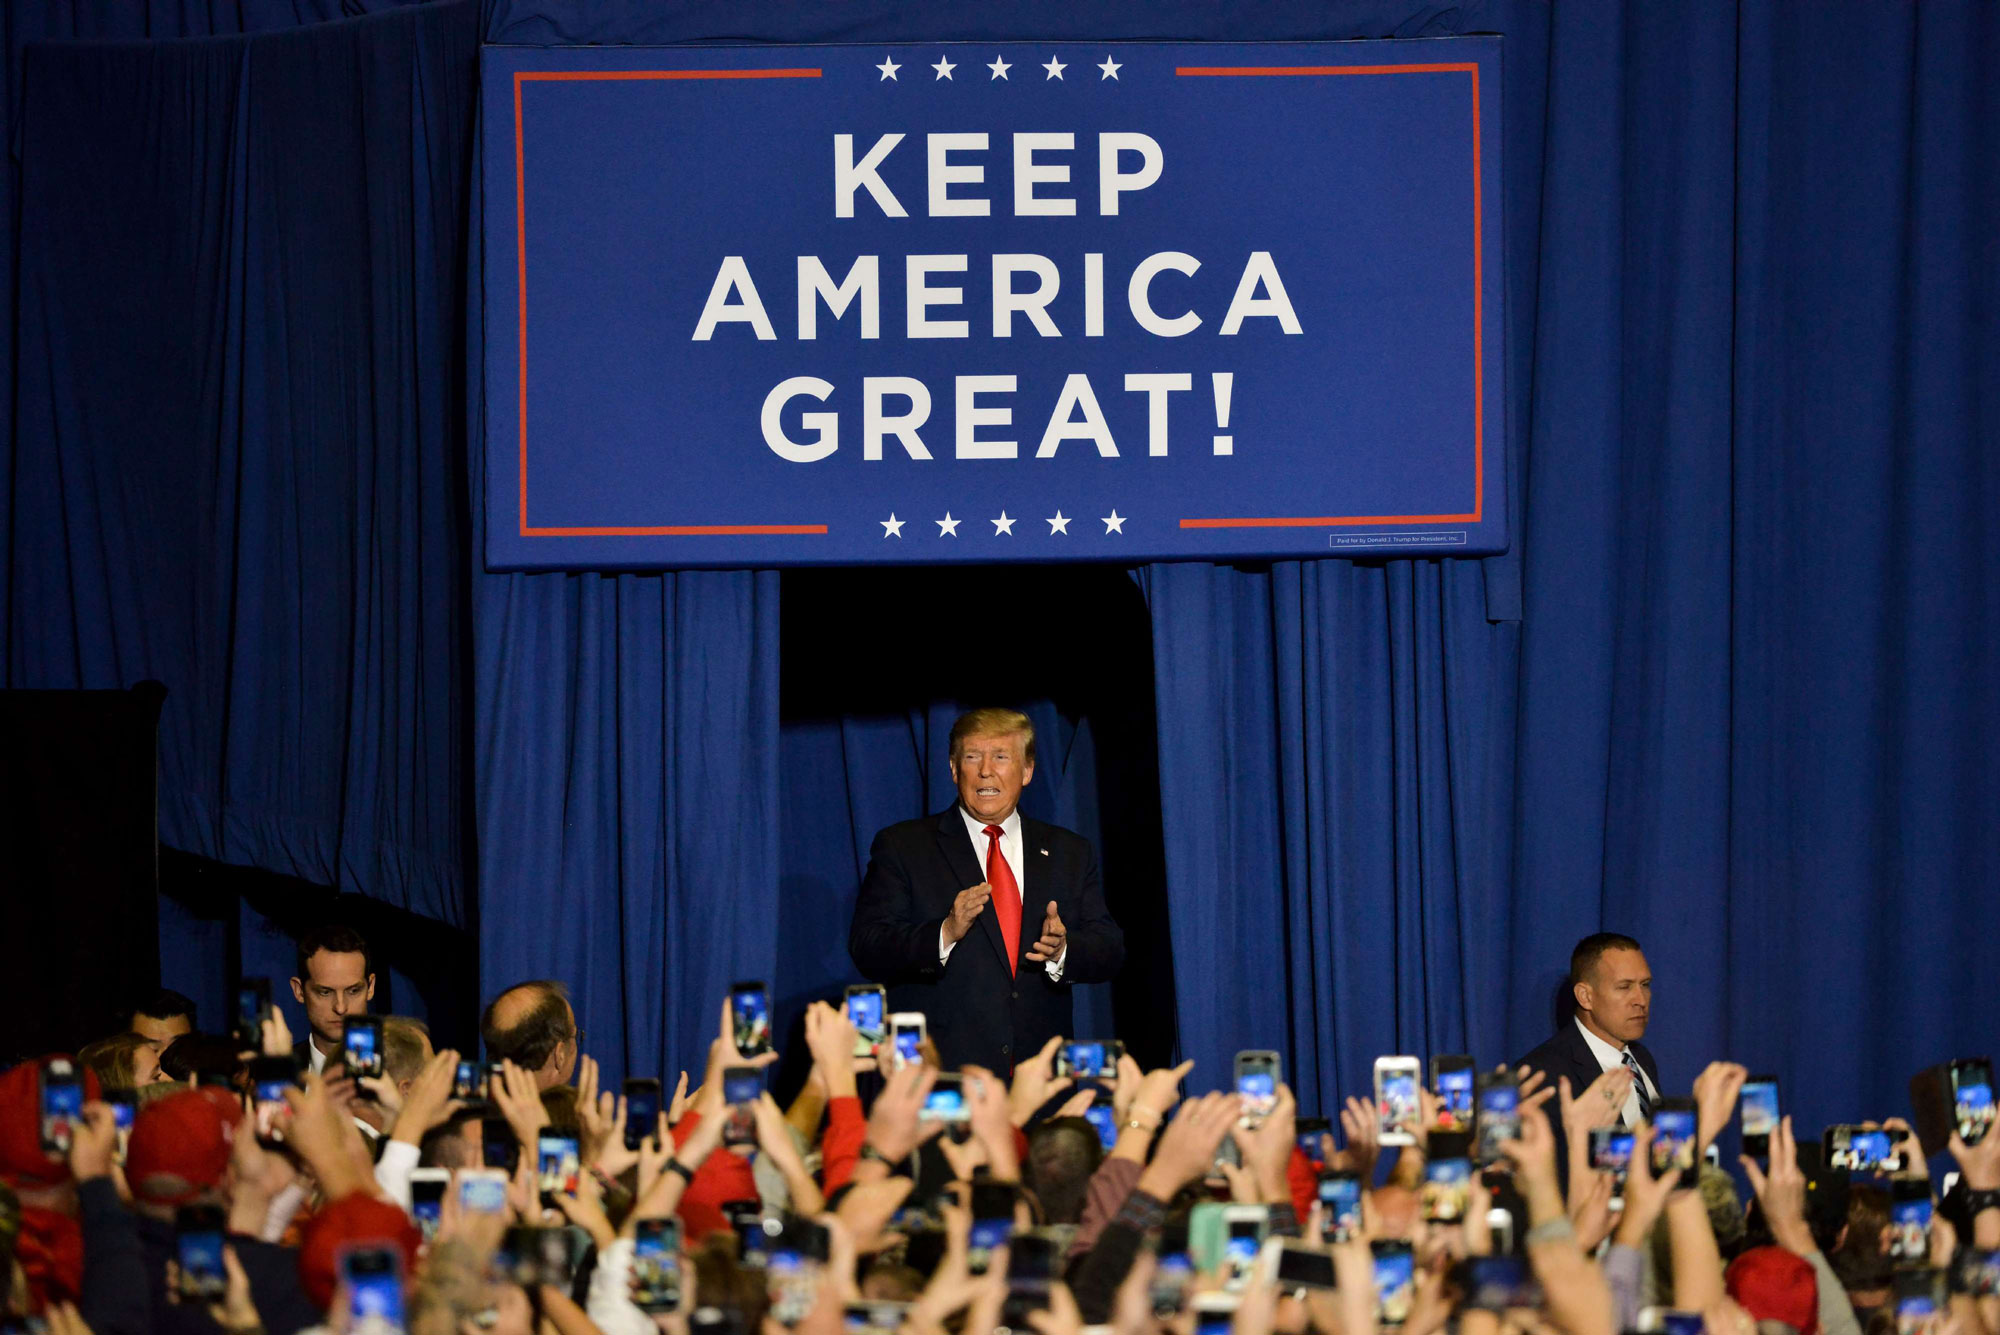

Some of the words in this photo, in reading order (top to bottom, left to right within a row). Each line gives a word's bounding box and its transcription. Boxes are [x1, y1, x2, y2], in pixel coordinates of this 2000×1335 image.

[833, 131, 1165, 219] KEEP
[691, 250, 1305, 342] AMERICA
[760, 371, 1235, 464] GREAT!
[1360, 537, 1366, 545] by
[1393, 536, 1412, 544] Trump
